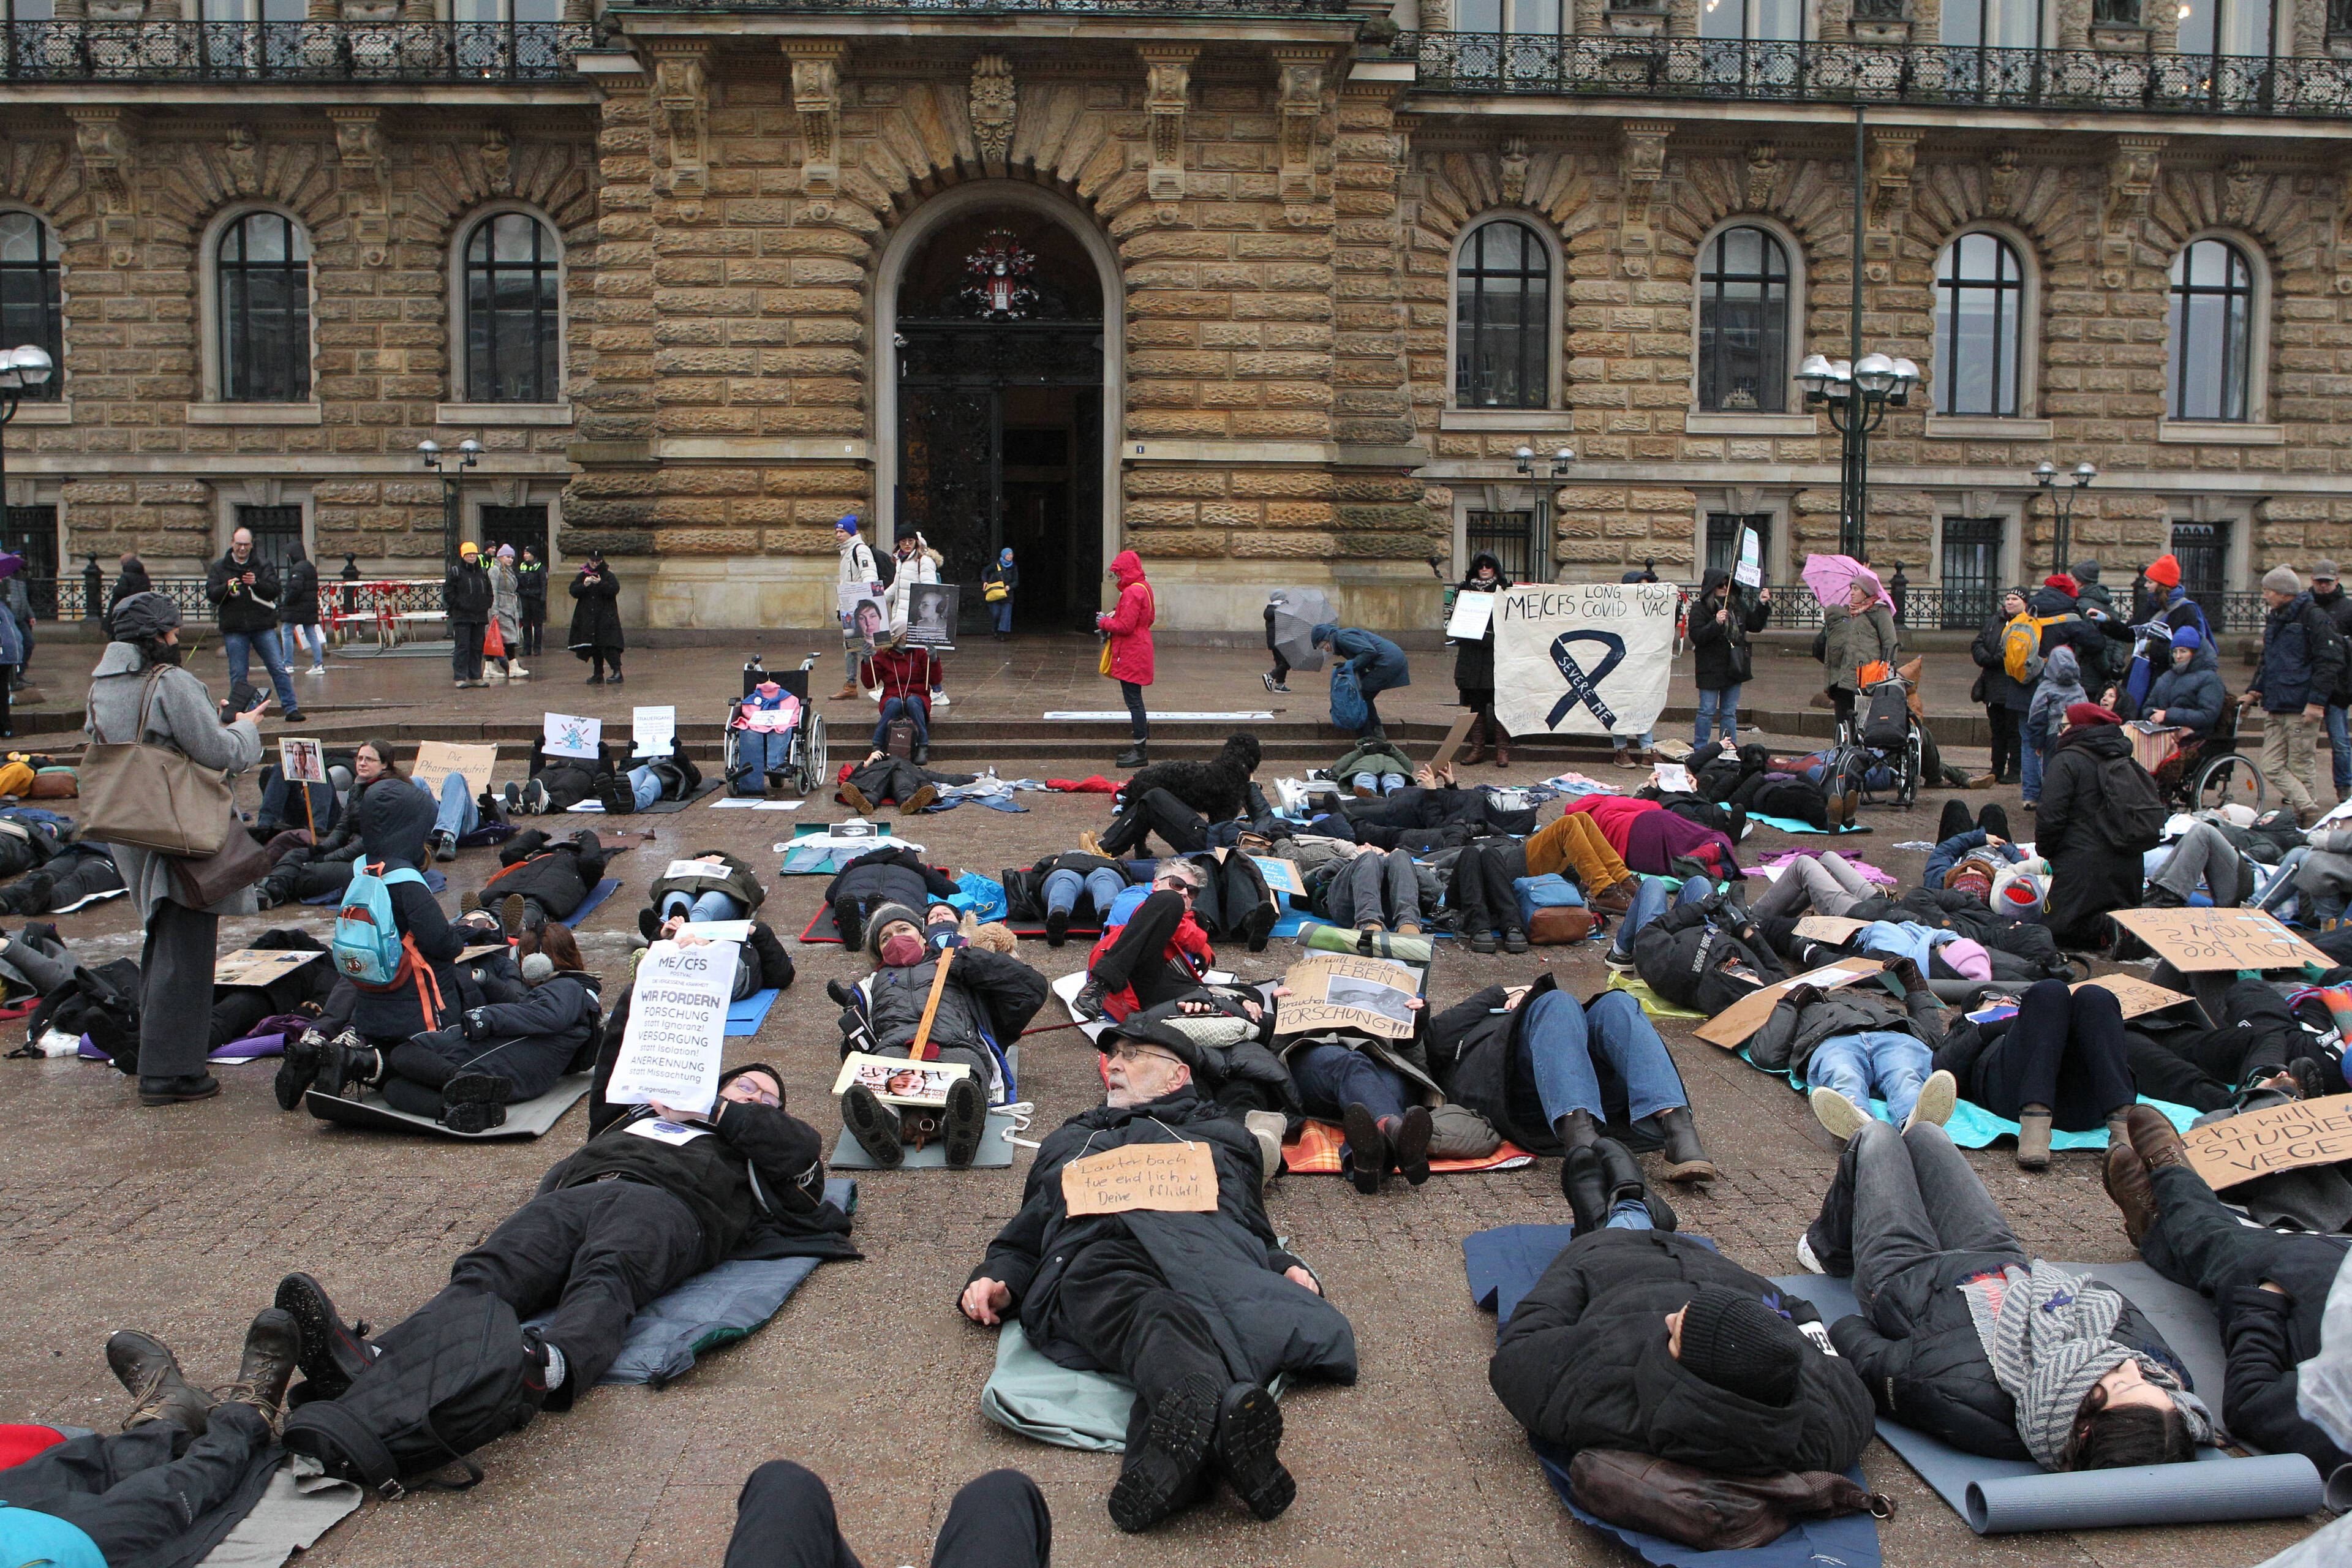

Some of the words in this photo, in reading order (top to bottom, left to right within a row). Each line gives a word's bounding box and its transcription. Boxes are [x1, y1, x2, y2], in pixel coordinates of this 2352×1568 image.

[1585, 586, 1621, 600] LONG
[1636, 584, 1677, 600] POST-
[1505, 590, 1575, 622] ME/CFS
[1581, 600, 1627, 617] COVID
[1642, 600, 1669, 617] VAC
[1558, 657, 1594, 699] SEVERE
[1591, 702, 1612, 723] ME
[447, 750, 462, 761] Die
[418, 760, 488, 774] Pharmaindustrie
[423, 775, 443, 784] muss
[658, 956, 708, 971] ME/CFS
[1296, 957, 1318, 968] Ich
[1325, 955, 1348, 964] will
[1355, 958, 1405, 976] wieder
[1327, 963, 1393, 985] LEBEN
[641, 990, 658, 1001] WIR
[660, 990, 721, 1009] FORDERN
[1278, 996, 1325, 1009] brauchen
[644, 1006, 709, 1022] FORSCHUNG
[662, 1019, 704, 1032] Ignoranz!
[638, 1031, 708, 1047] VERSORGUNG
[658, 1044, 699, 1057] Isolation!
[631, 1056, 705, 1072] ANERKENNUNG
[647, 1068, 701, 1084] Missachtung
[638, 1086, 680, 1096] #LiegendDemo
[2181, 1126, 2239, 1151] Ich
[2257, 1105, 2316, 1126] will
[1085, 1177, 1107, 1188] tue
[1098, 1190, 1132, 1205] Deine
